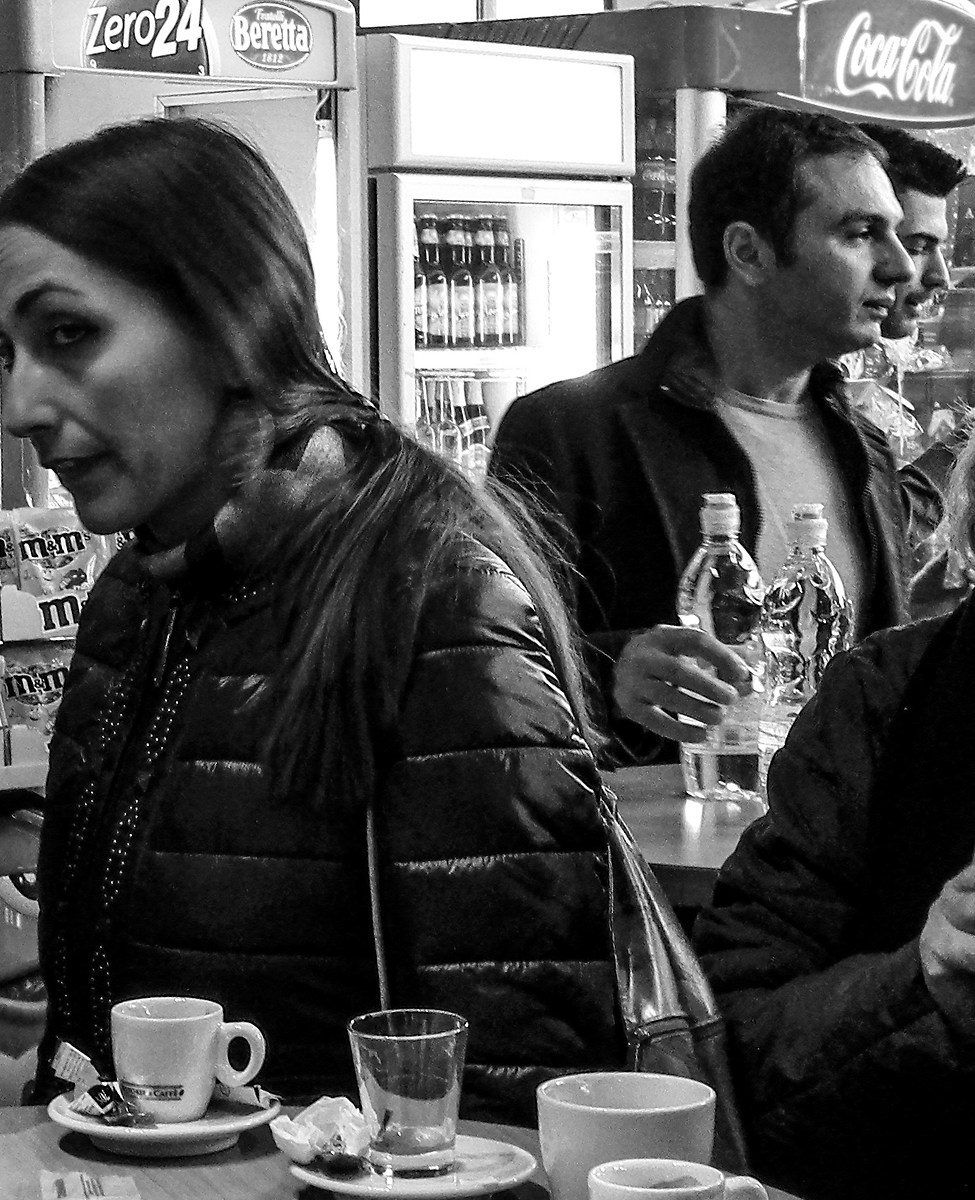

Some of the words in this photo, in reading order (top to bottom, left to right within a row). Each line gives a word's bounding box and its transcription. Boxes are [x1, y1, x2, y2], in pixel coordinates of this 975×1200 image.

[232, 14, 311, 52] Beretta
[261, 52, 283, 64] 1812
[835, 11, 963, 104] Coca-Cola
